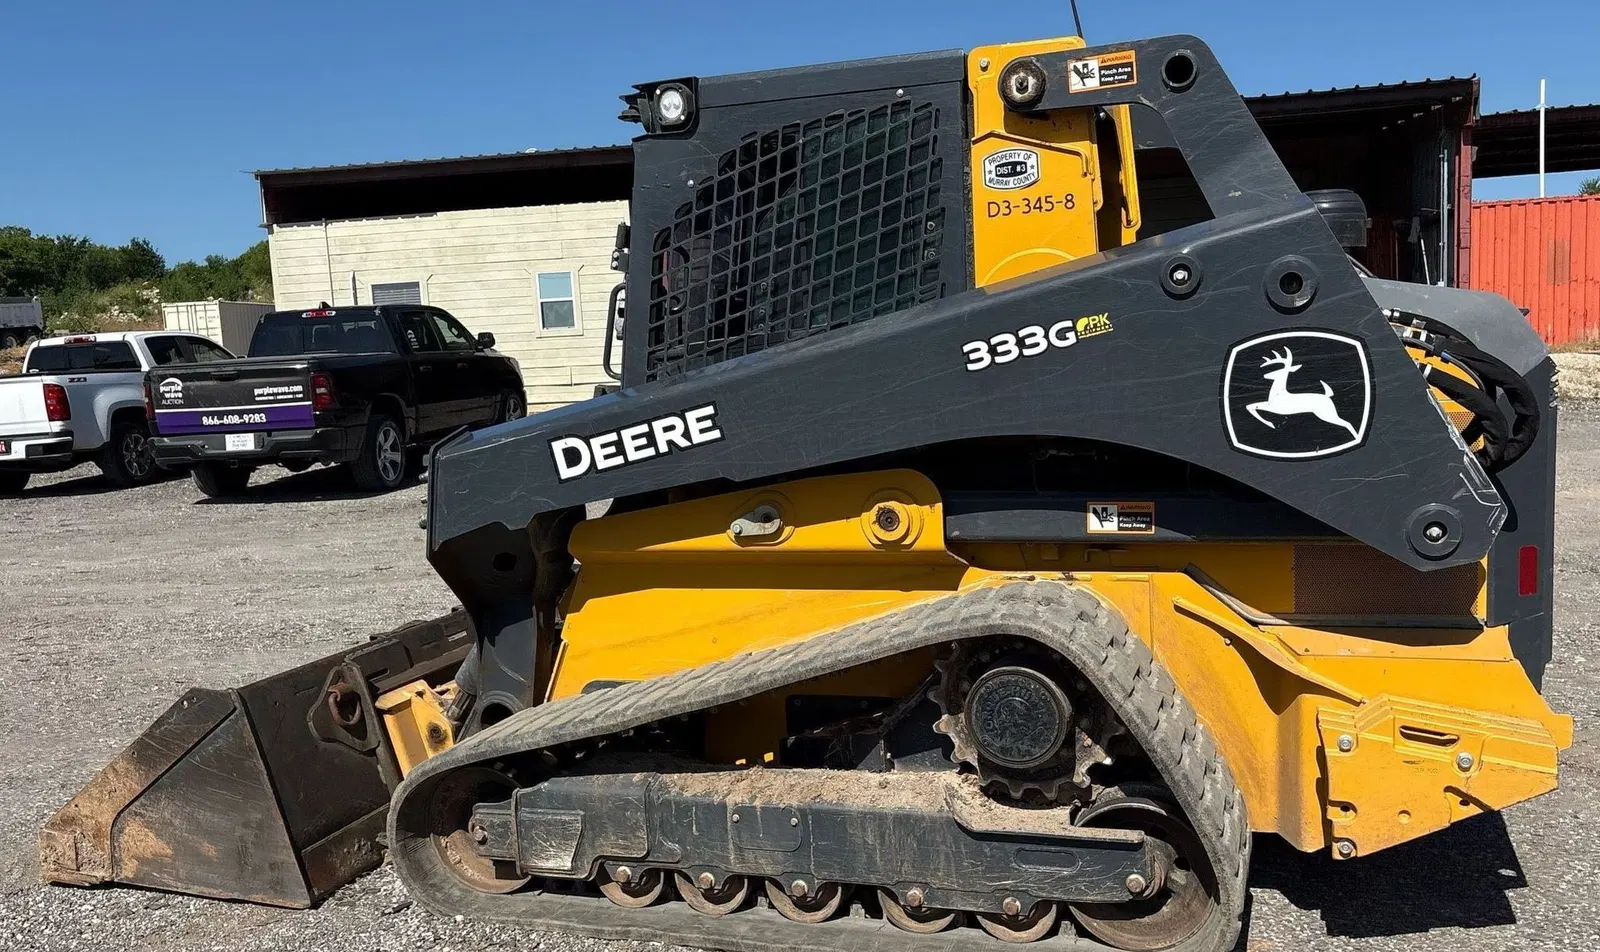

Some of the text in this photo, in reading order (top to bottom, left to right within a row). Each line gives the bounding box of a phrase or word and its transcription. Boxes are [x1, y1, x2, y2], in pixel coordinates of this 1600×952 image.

[987, 152, 1033, 166] PROPERTY OF
[996, 164, 1027, 175] DIST. #3
[988, 171, 1036, 187] MURRAY COUNTY
[987, 193, 1075, 218] D3-345-8
[962, 320, 1077, 371] 333G
[160, 383, 182, 393] purple
[202, 413, 267, 426] 866-608-9283
[551, 405, 722, 480] DEERE
